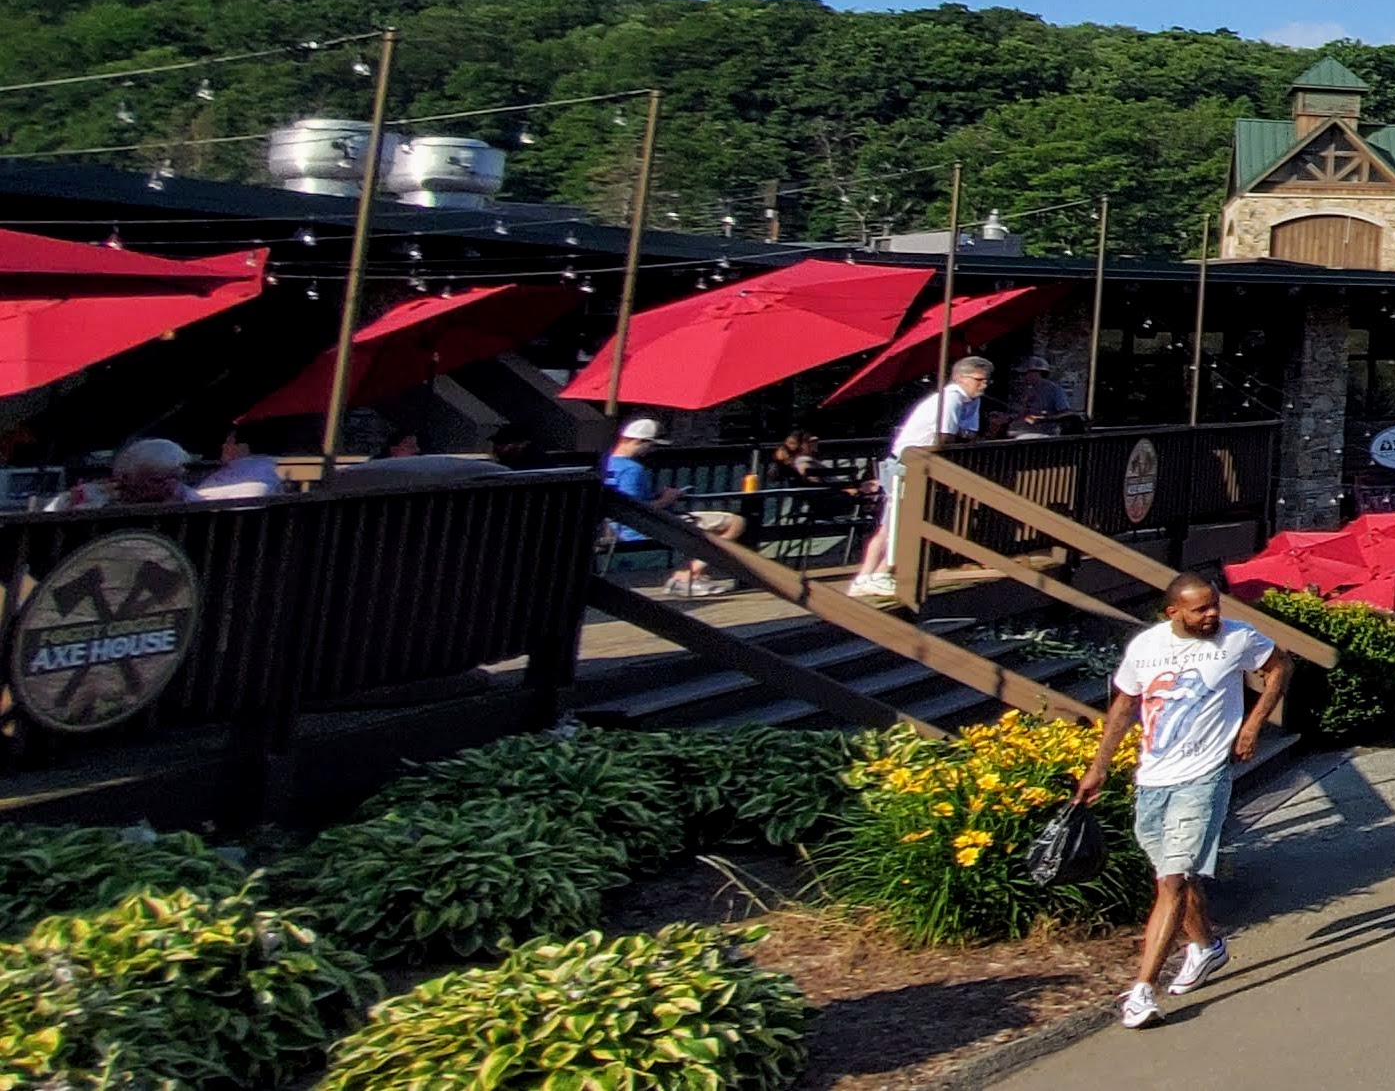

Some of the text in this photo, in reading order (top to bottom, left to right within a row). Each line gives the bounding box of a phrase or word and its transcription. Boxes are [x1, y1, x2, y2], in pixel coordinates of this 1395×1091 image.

[30, 643, 87, 672] AXE
[88, 629, 177, 663] HOUSE
[1184, 650, 1228, 664] STONES
